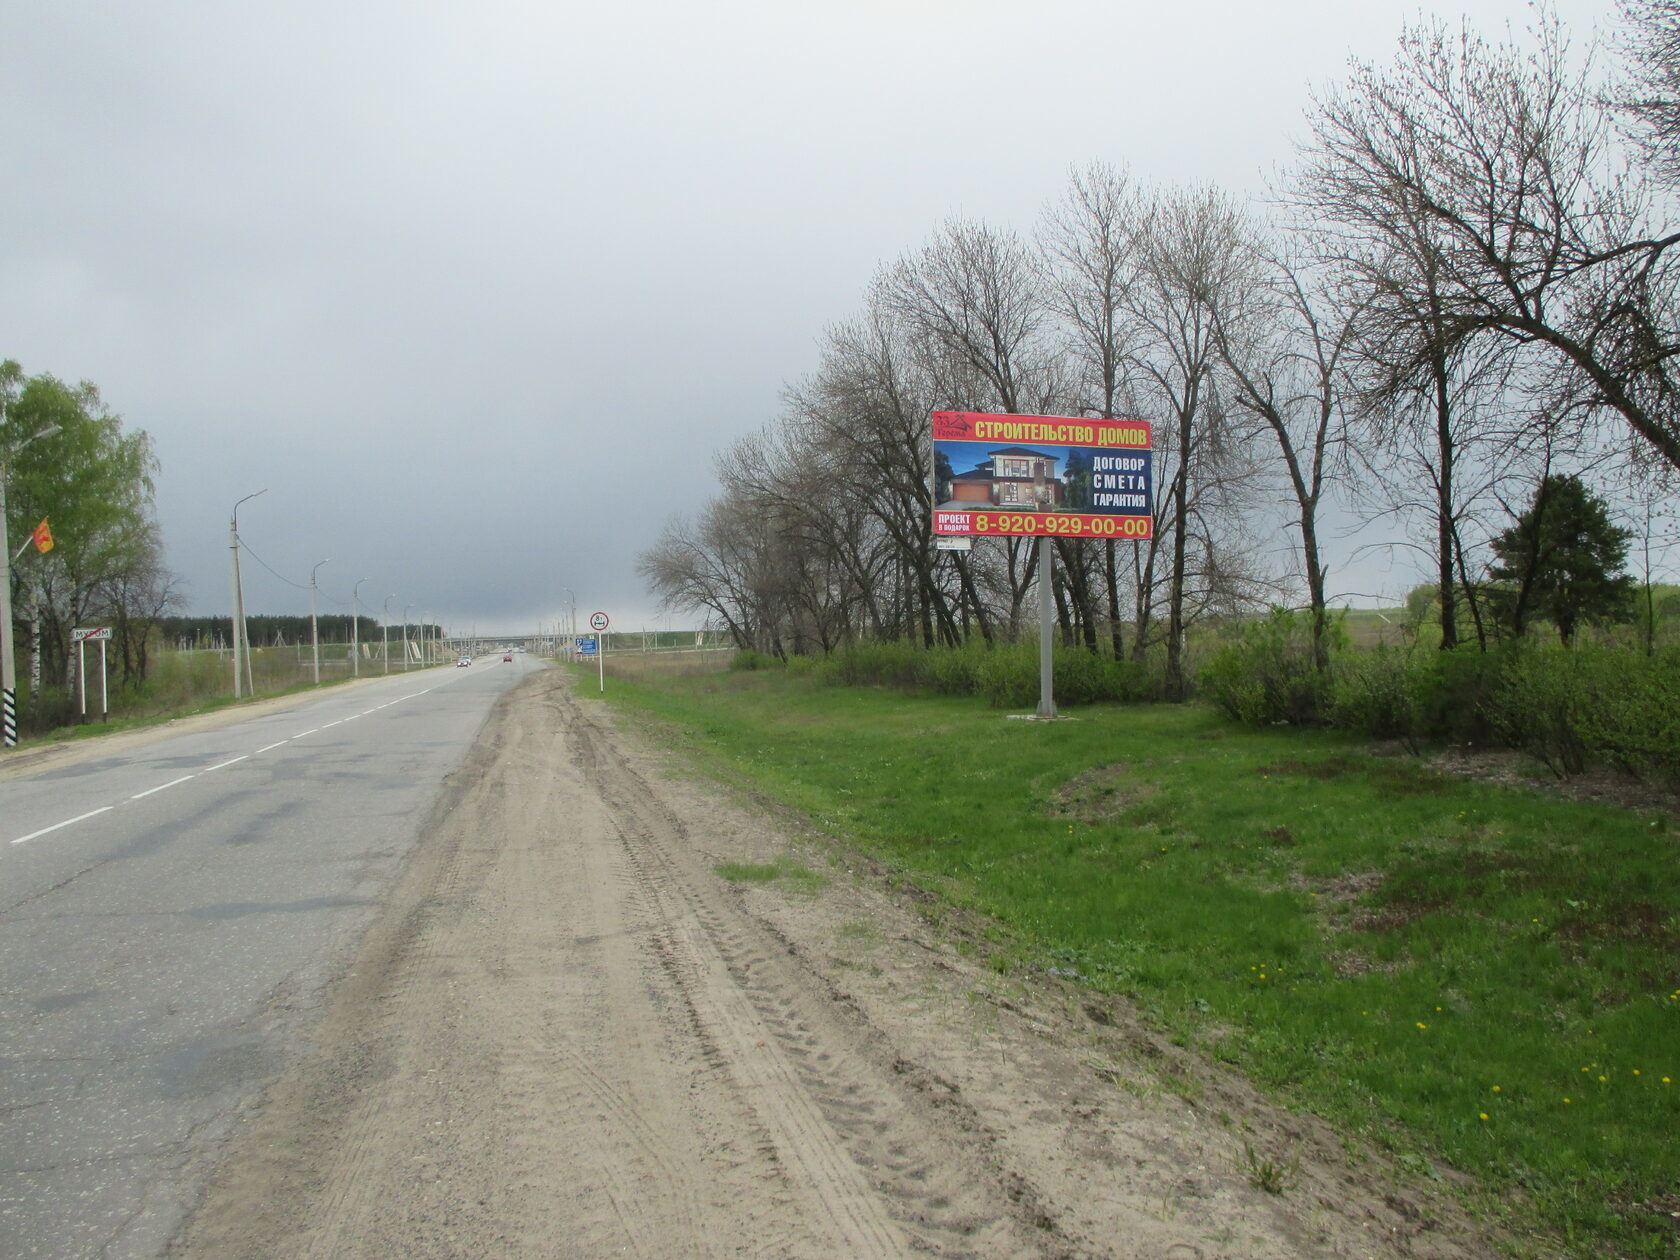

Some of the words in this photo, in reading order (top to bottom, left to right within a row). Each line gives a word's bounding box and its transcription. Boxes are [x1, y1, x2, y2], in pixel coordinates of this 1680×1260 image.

[975, 421, 1094, 443] СТРОИТЕЛЬСТВО
[1098, 427, 1147, 446] ДОМОВ
[1093, 456, 1144, 471] ДОГОВОР
[1093, 475, 1146, 490] СМЕТА
[1093, 493, 1146, 507] ГАРАНТИЯ
[938, 514, 971, 524] ПРОЕКТ
[975, 515, 1148, 536] 8-920-929-00-00
[943, 524, 970, 532] ПОДАРОК
